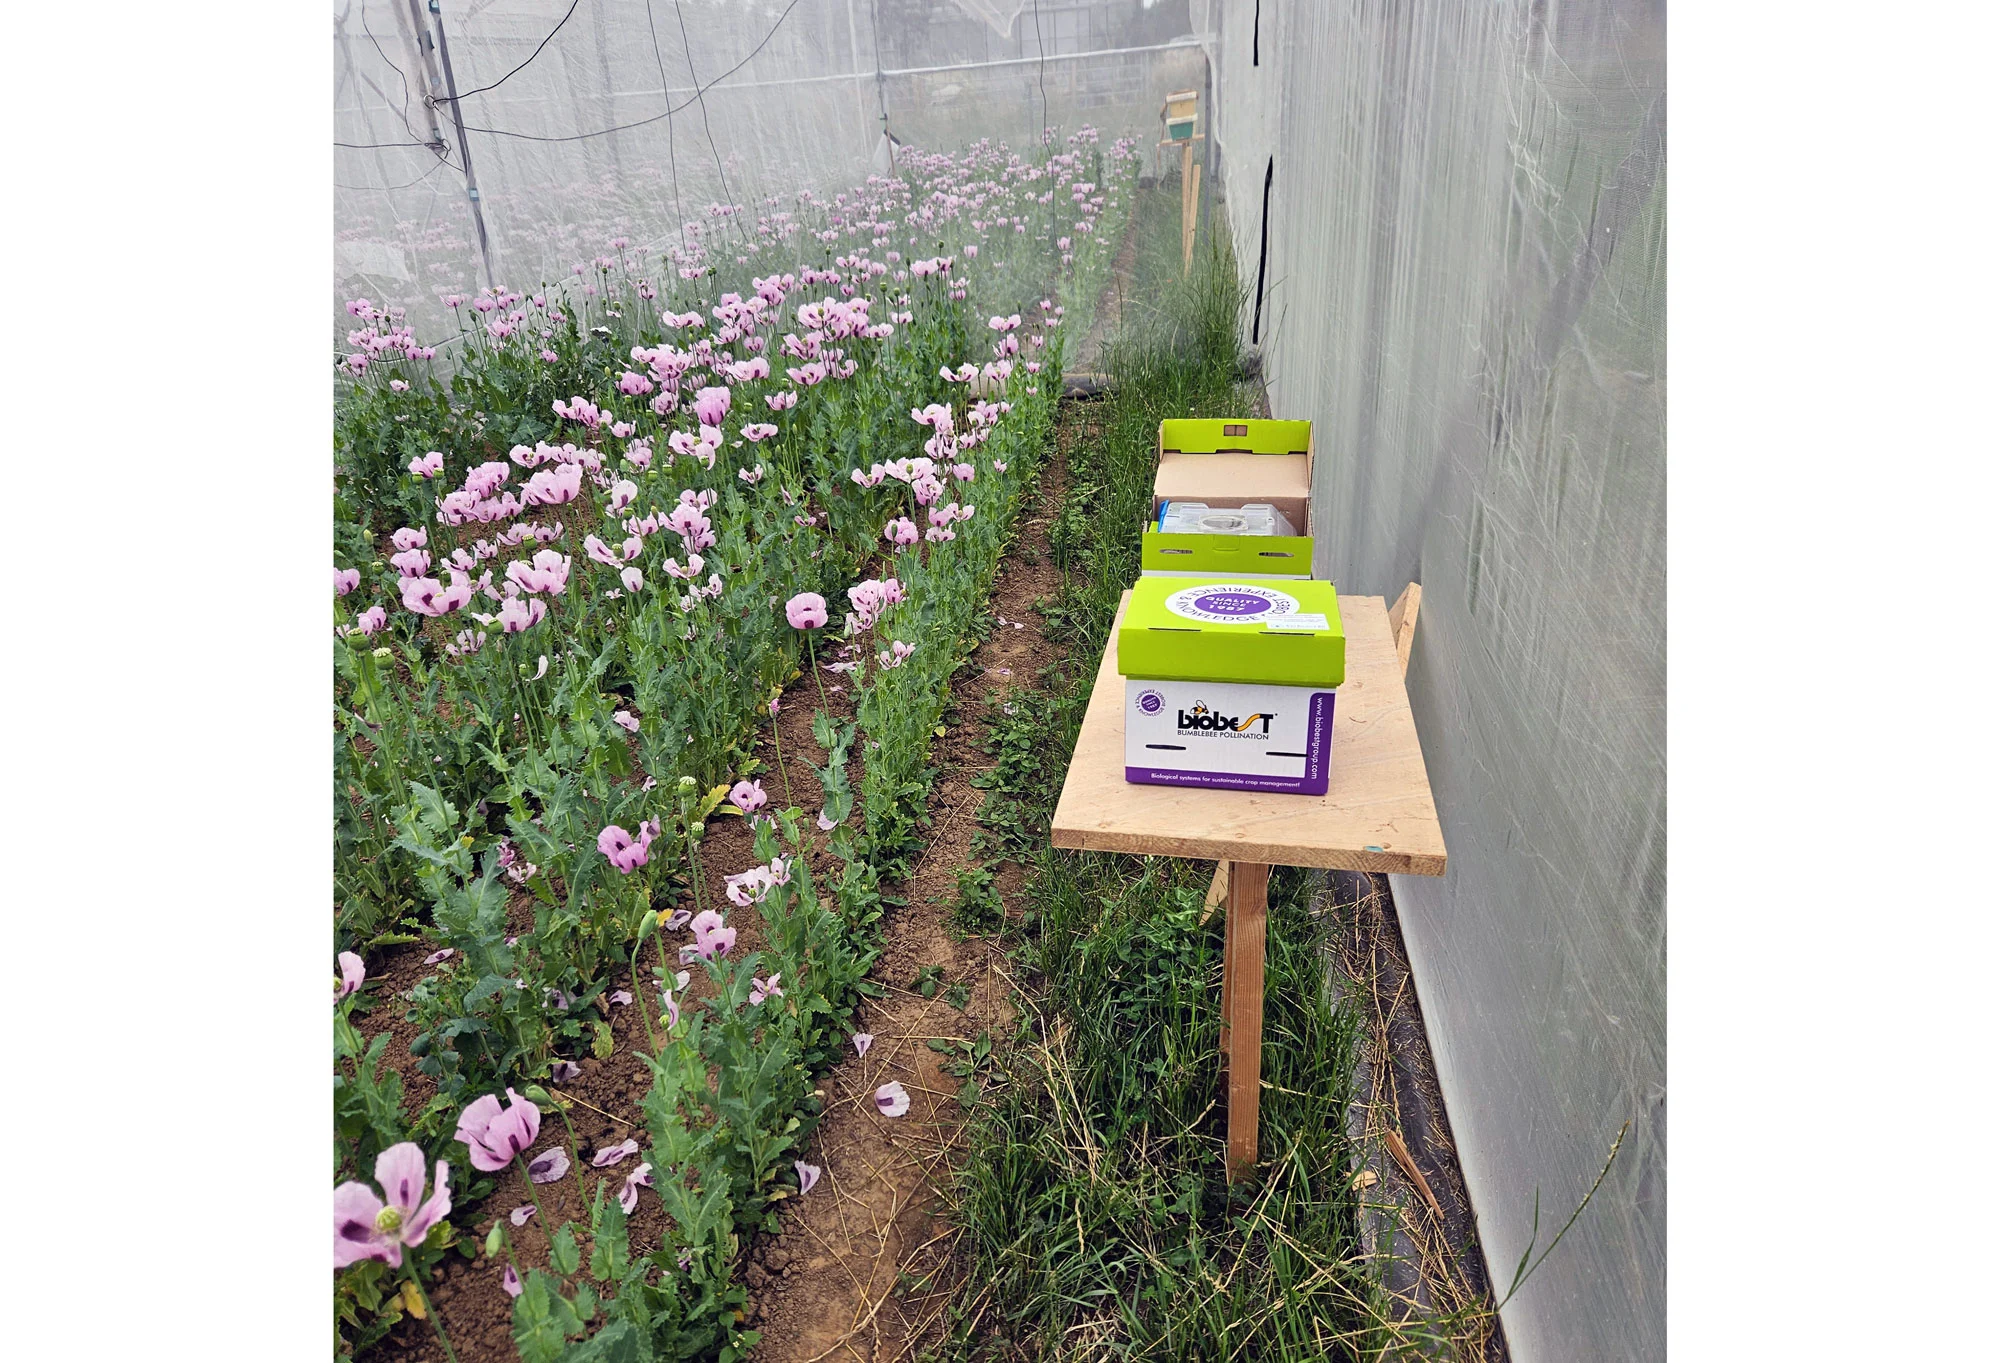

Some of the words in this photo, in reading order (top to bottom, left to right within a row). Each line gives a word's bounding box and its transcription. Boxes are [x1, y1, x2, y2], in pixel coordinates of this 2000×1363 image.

[1187, 587, 1278, 598] EXPERIENCE
[1205, 596, 1260, 605] QUALITY
[1176, 600, 1261, 621] KNOWLEDGE
[1177, 729, 1217, 738] BUMBLEBEE
[1219, 731, 1269, 740] POLLINATION
[1311, 697, 1324, 779] www.biobestgroup.com
[1150, 772, 1179, 780] Biological
